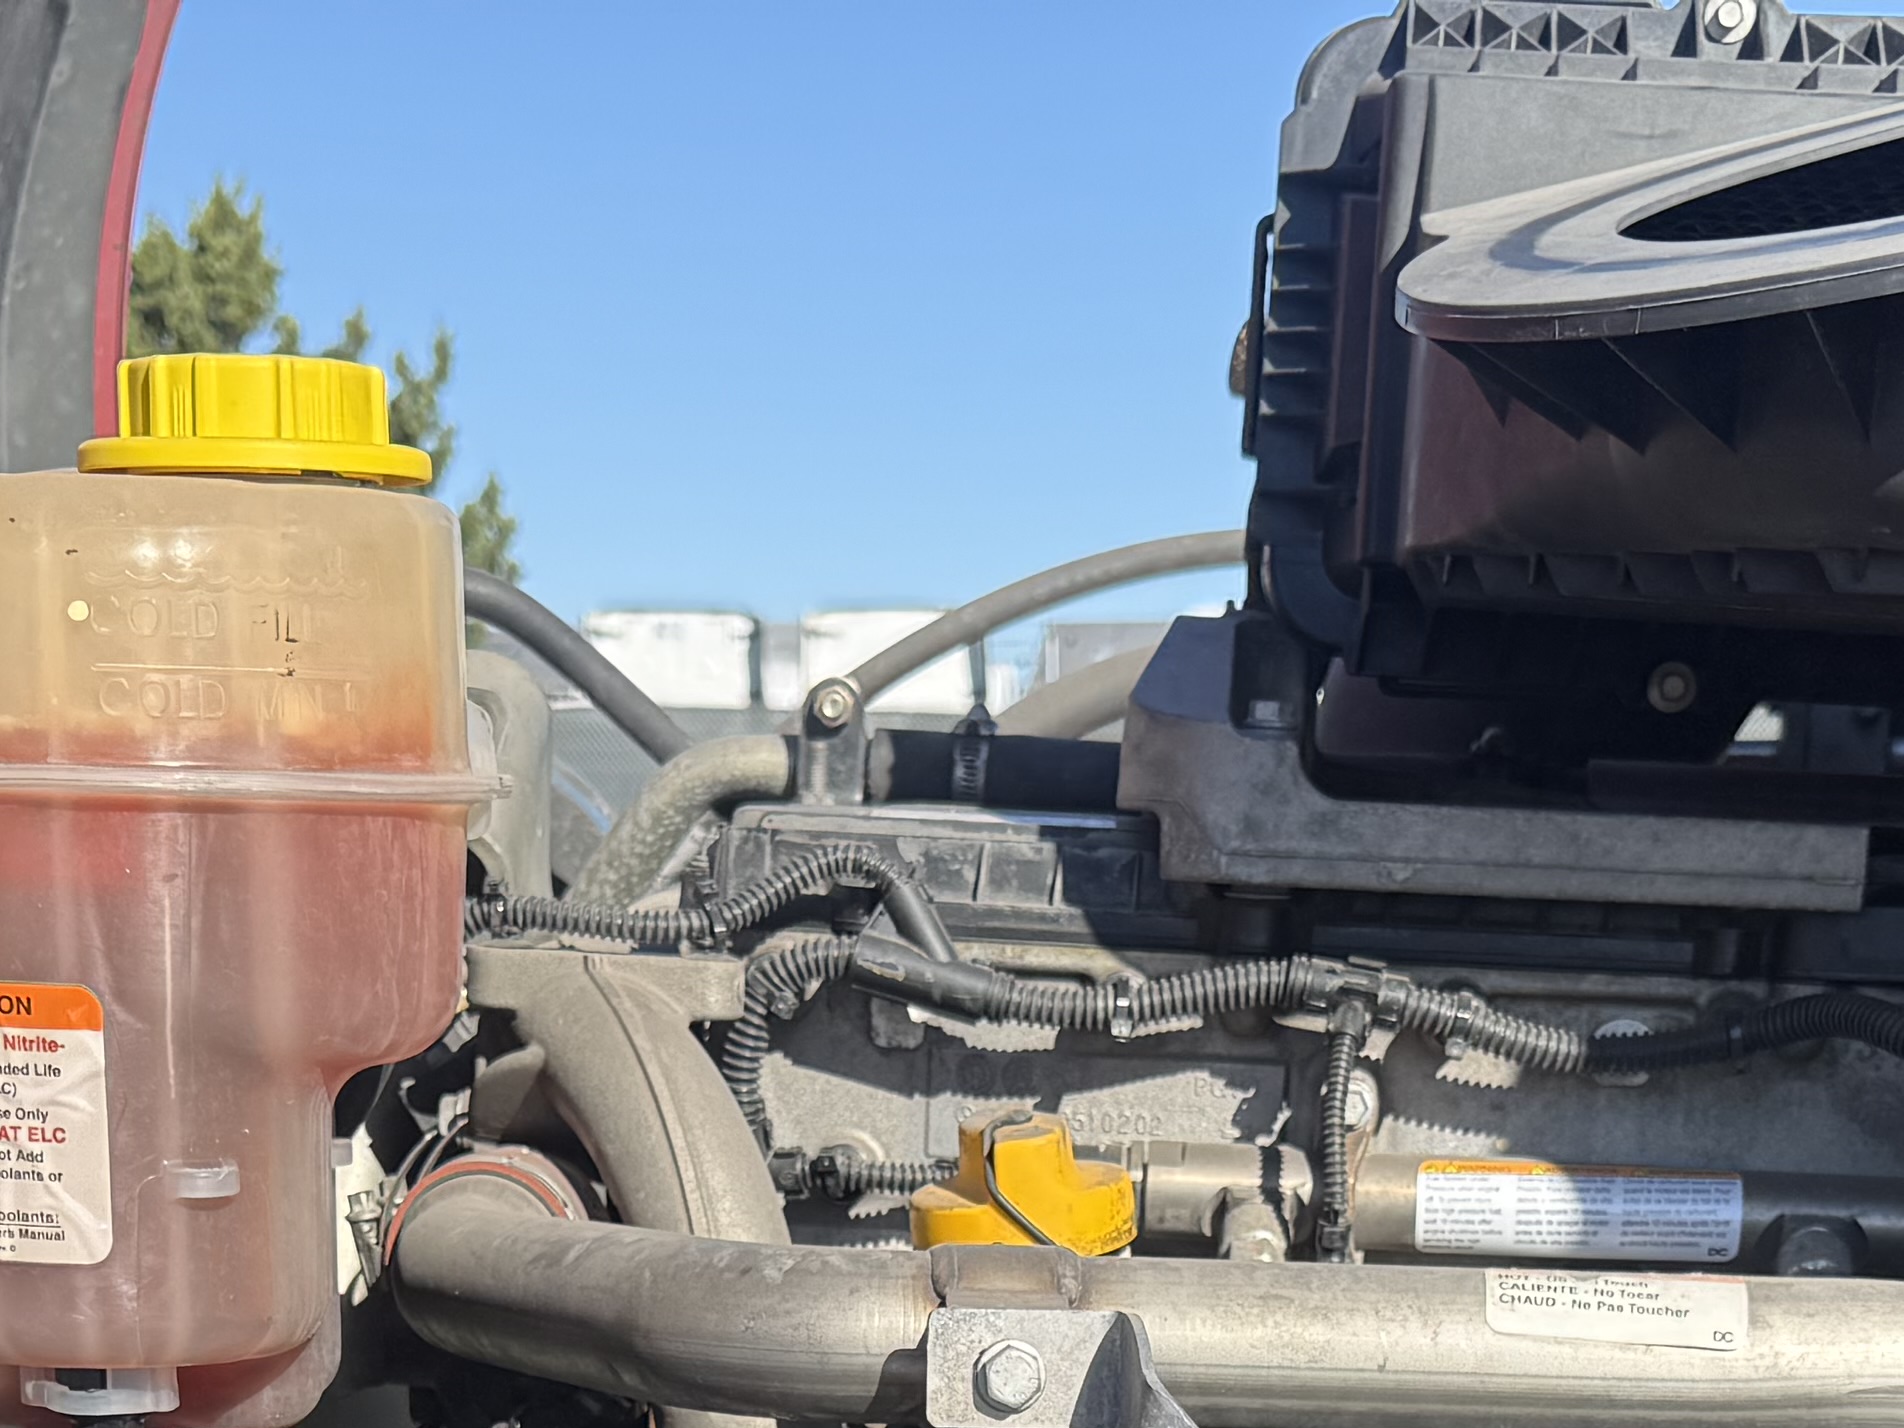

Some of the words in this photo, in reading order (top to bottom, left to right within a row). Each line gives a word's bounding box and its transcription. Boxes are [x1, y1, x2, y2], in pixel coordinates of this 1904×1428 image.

[99, 677, 226, 718] COLD
[3, 1034, 65, 1053] Nitrite-
[34, 1063, 61, 1078] Life
[15, 1107, 48, 1123] Only
[27, 1127, 66, 1144] ELC
[16, 1149, 43, 1163] Add
[48, 1171, 63, 1183] or
[18, 1229, 66, 1241] Manual
[1708, 1248, 1728, 1257] DC
[1499, 1282, 1578, 1295] CALIENTE
[1594, 1289, 1614, 1298] No
[1620, 1289, 1660, 1300] Tocar
[1499, 1294, 1556, 1307] CHAUD
[1571, 1300, 1591, 1310] No
[1597, 1302, 1624, 1313] Pas
[1629, 1304, 1690, 1318] Toucher
[1713, 1331, 1734, 1343] DC
